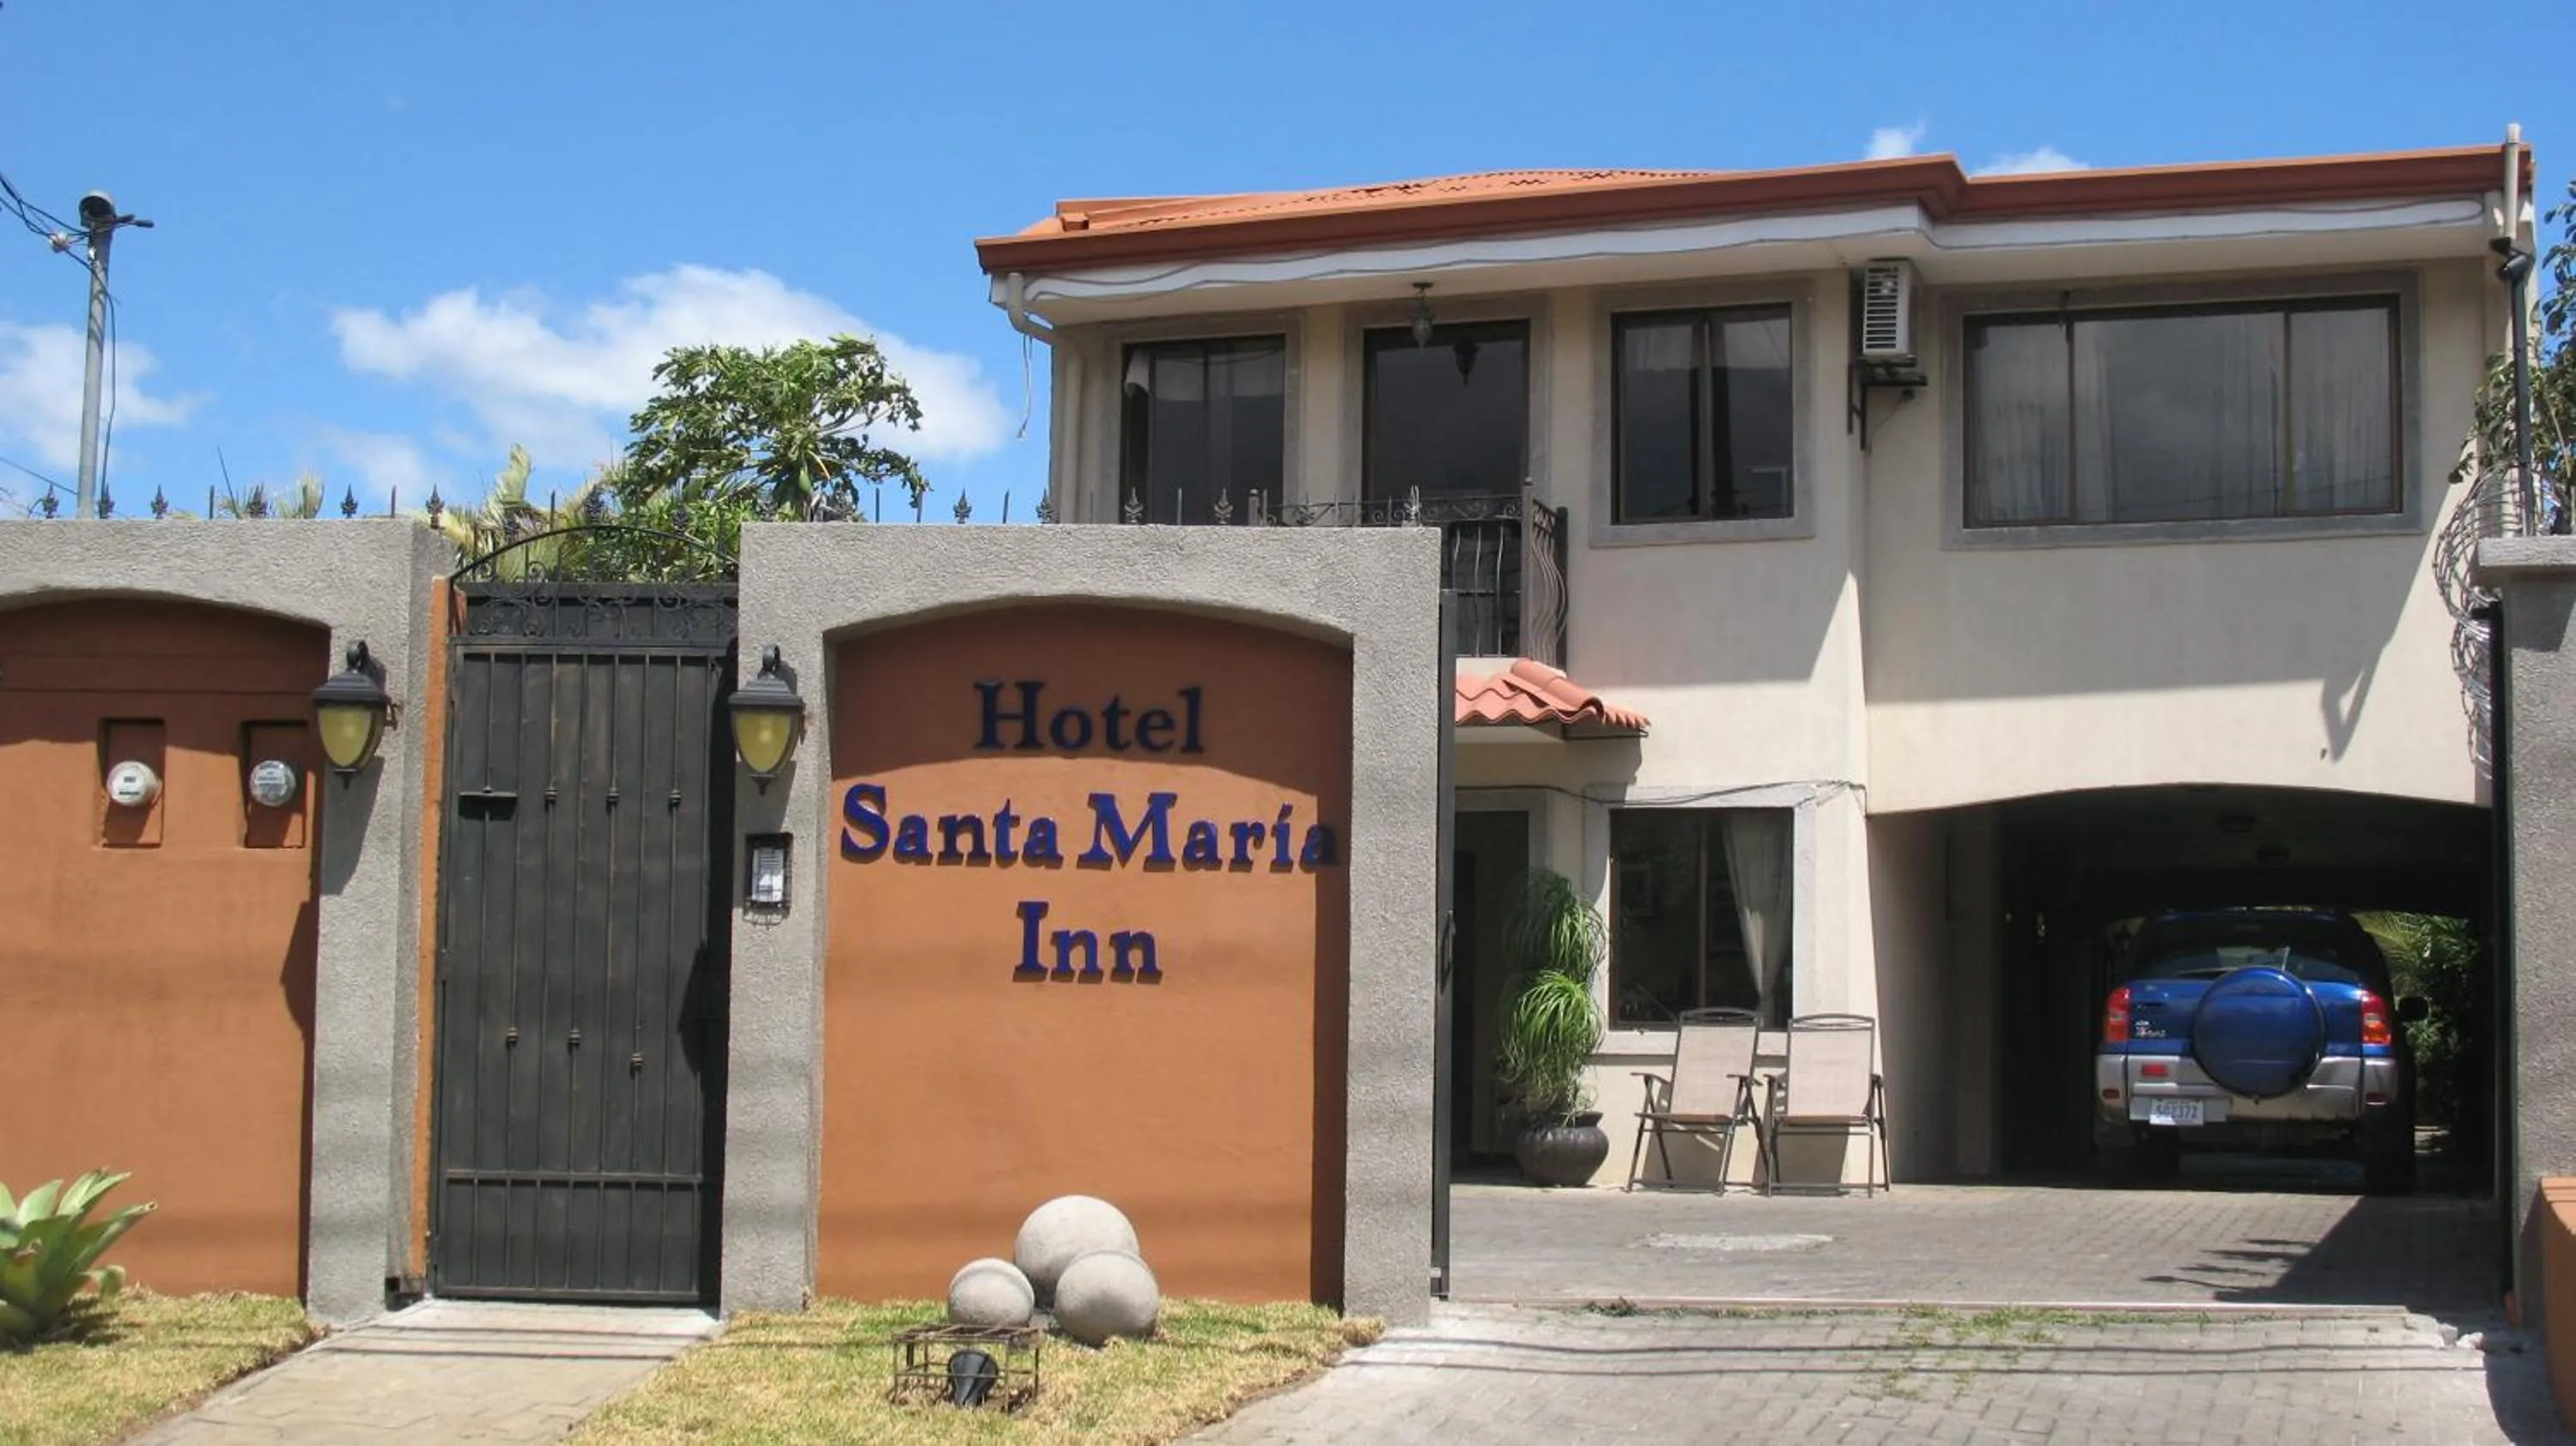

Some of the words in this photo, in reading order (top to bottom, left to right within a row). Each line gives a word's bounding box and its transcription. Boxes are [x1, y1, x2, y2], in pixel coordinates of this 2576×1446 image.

[973, 680, 1206, 754] Hotel
[840, 783, 1064, 869] Santa
[1076, 792, 1341, 873] María
[1012, 900, 1163, 984] Inn
